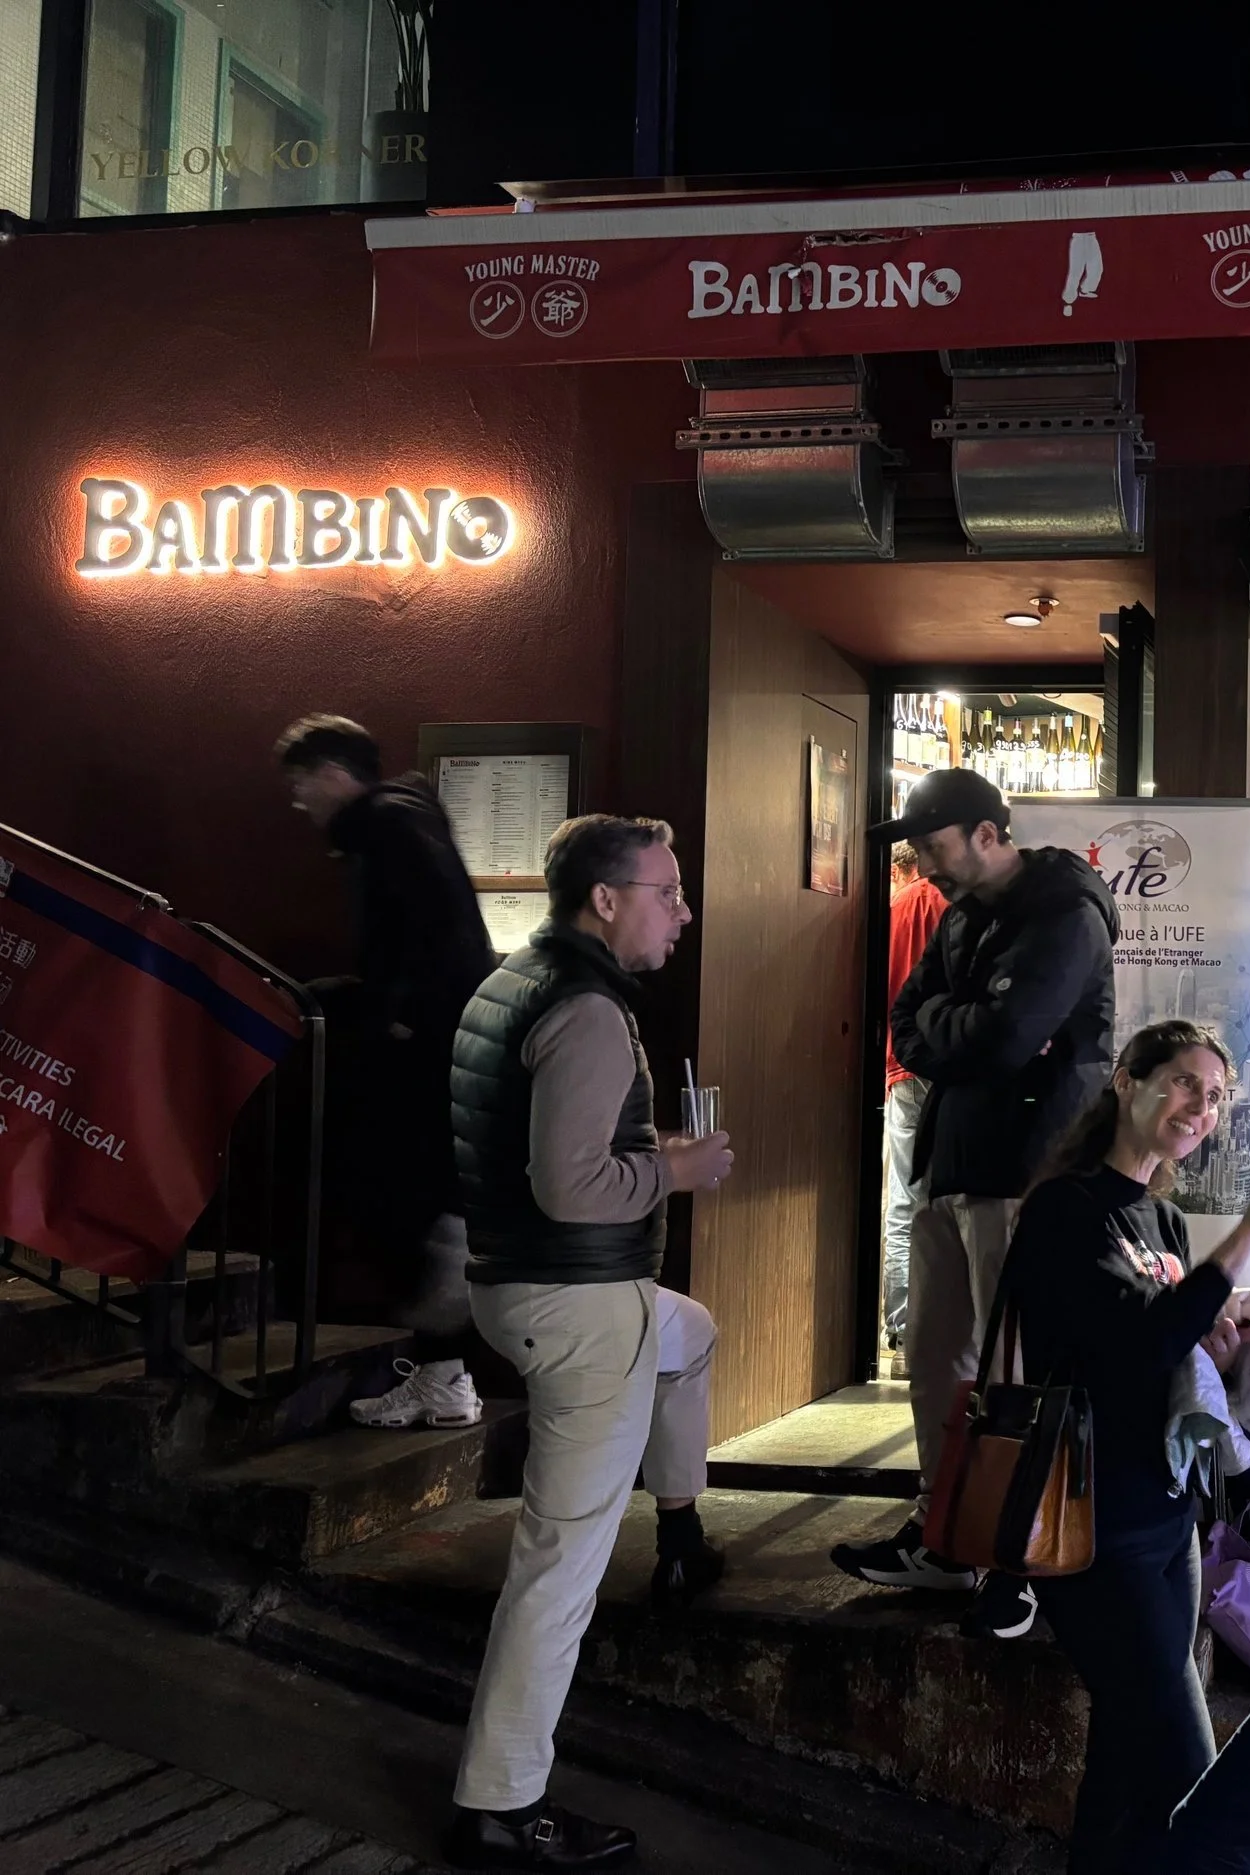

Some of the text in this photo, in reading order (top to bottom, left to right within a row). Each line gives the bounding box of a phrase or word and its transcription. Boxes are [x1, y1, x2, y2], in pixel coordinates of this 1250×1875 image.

[91, 145, 247, 182] YELLOW
[464, 254, 601, 283] YOUNG MASTER
[687, 260, 962, 319] BAMBINO
[75, 477, 512, 574] BAMBINO
[1117, 903, 1190, 912] ONG & MACAO
[1150, 925, 1159, 941] à
[1114, 956, 1222, 967] de Hong Kong et Macao
[1145, 948, 1156, 956] de
[0, 1074, 56, 1121] CARA
[58, 1107, 127, 1162] ILEGAL
